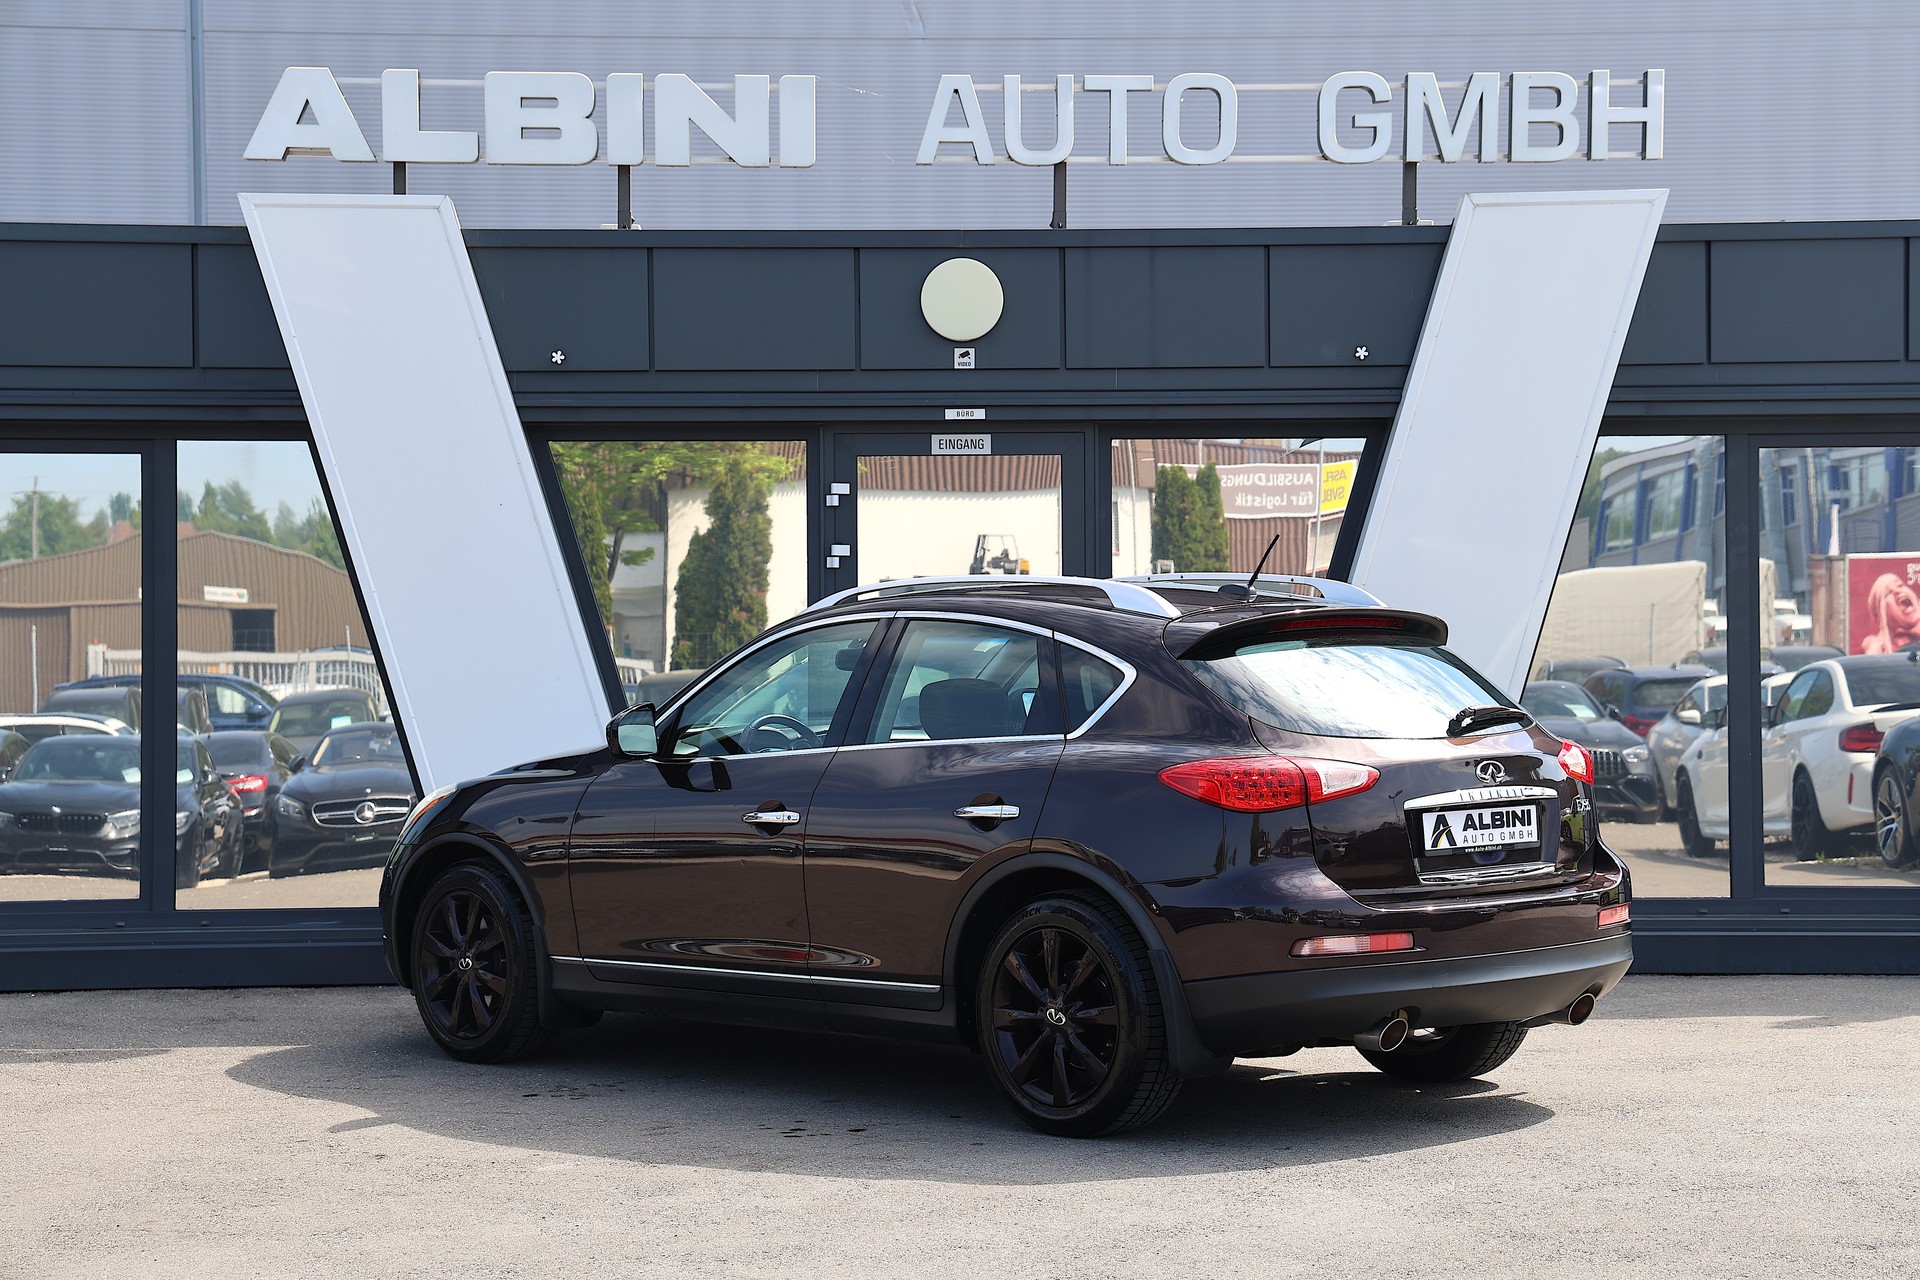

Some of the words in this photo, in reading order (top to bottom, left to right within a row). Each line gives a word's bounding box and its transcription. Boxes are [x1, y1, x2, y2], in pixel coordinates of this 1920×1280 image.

[242, 66, 817, 168] ALBINI
[916, 71, 1238, 166] AUTO
[1317, 68, 1666, 164] GMBH
[956, 410, 975, 418] BÜRO
[938, 438, 985, 450] EINGANG
[1462, 808, 1532, 832] ALBINI
[1462, 832, 1495, 844] AUTO
[1499, 829, 1534, 842] GMBH
